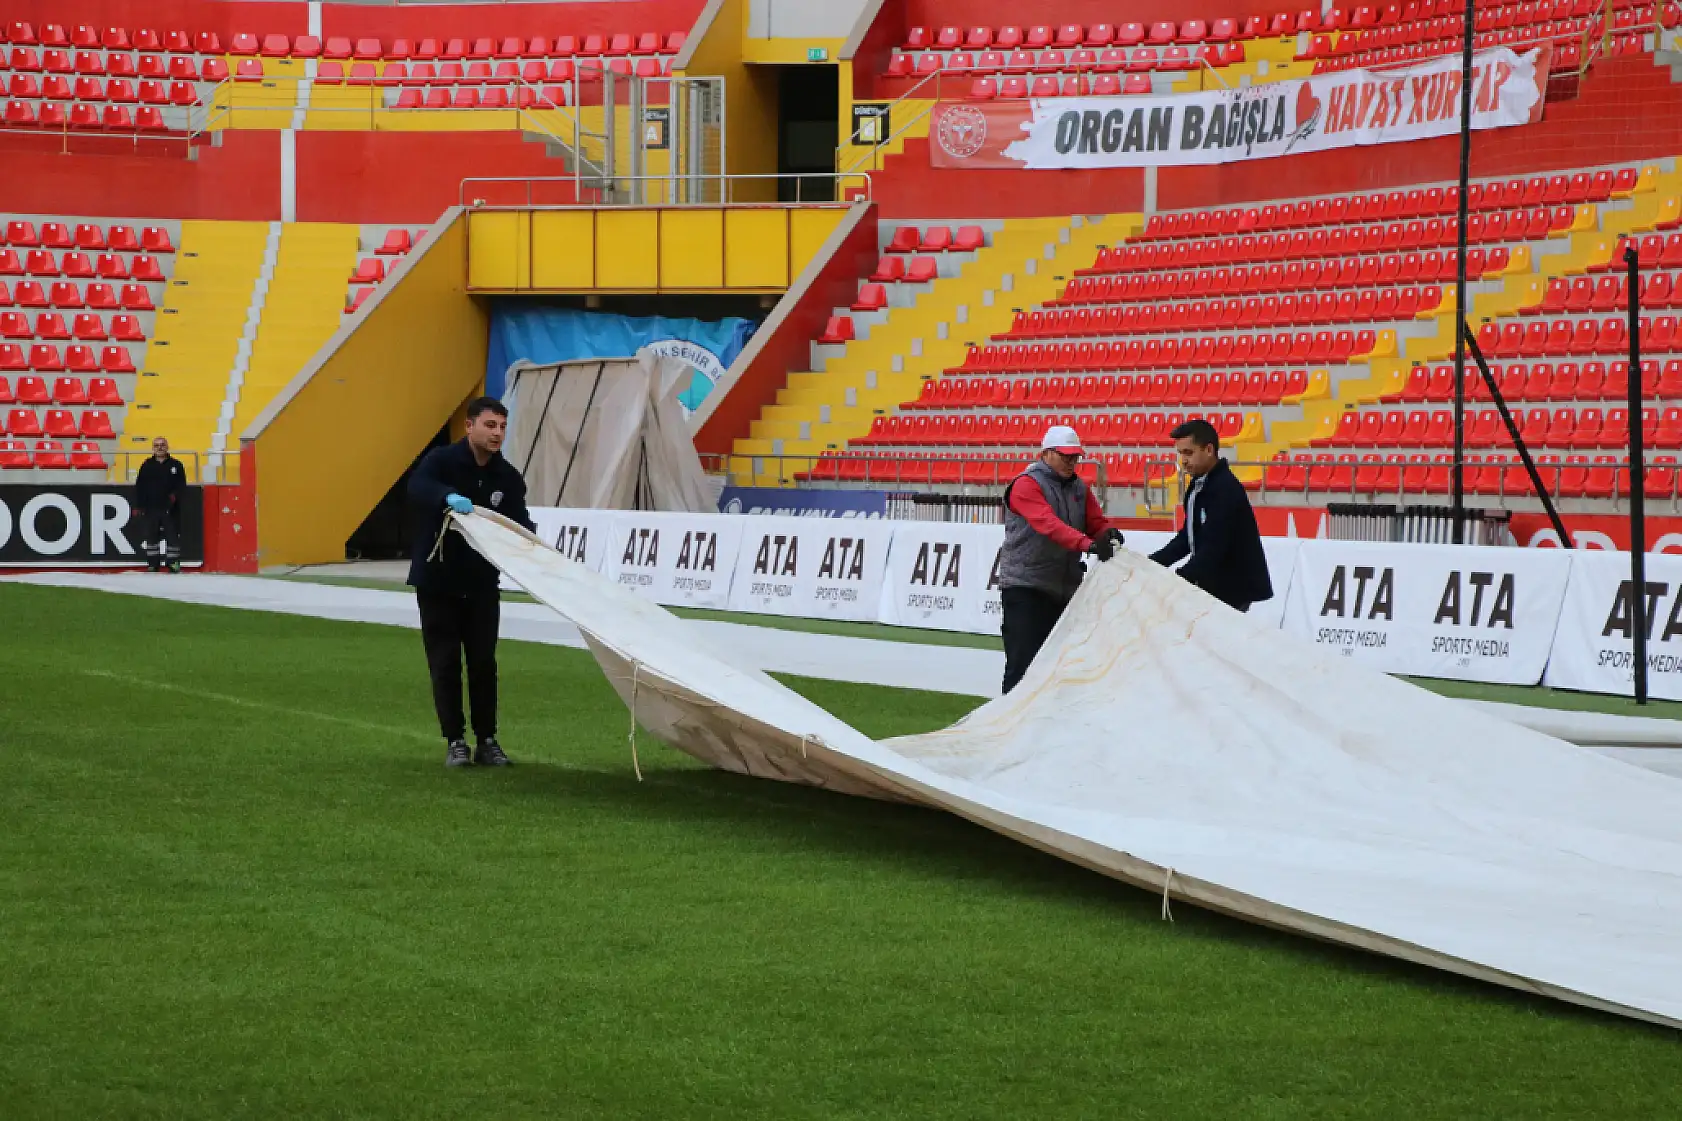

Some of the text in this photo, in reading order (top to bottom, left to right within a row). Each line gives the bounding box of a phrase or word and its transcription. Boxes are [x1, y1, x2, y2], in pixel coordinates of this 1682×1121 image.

[1055, 106, 1174, 154] ORGAN
[1180, 93, 1286, 156] BAĞIŞLA
[1324, 79, 1405, 135] HAYAT
[0, 493, 136, 555] OR
[555, 525, 588, 563] ATA
[621, 528, 659, 567] ATA
[676, 531, 717, 572] ATA
[753, 534, 798, 576] ATA
[817, 537, 866, 580] ATA
[909, 542, 961, 588] ATA
[1320, 565, 1394, 620] ATA
[1433, 571, 1514, 629] ATA
[1601, 579, 1682, 641] ATA
[1316, 627, 1387, 648] SPORTS MEDIA
[1432, 636, 1510, 658] SPORTS MEDIA
[1597, 649, 1635, 669] SPOR
